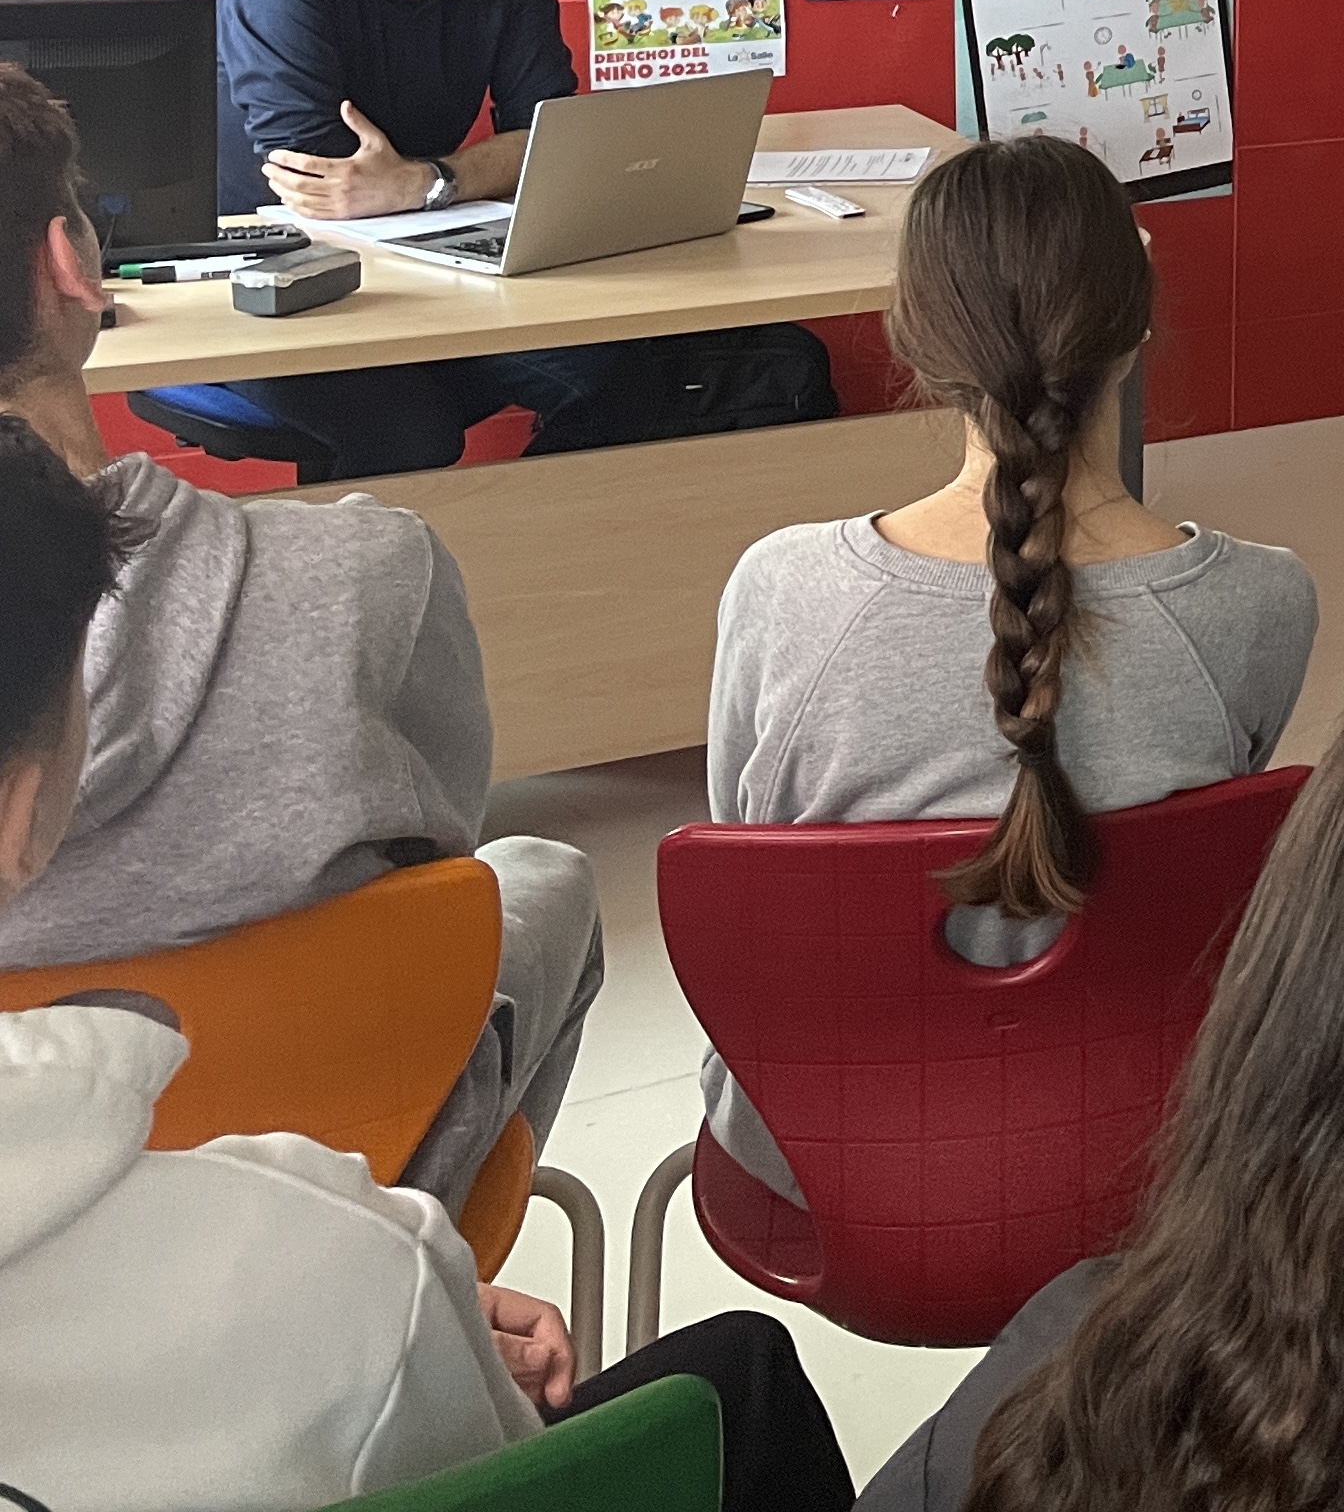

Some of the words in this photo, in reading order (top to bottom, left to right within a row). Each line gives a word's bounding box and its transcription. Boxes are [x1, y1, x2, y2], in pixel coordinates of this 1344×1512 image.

[680, 47, 710, 58] DEL
[727, 51, 739, 62] La
[595, 63, 654, 82] NIÑO
[659, 62, 709, 78] 2022
